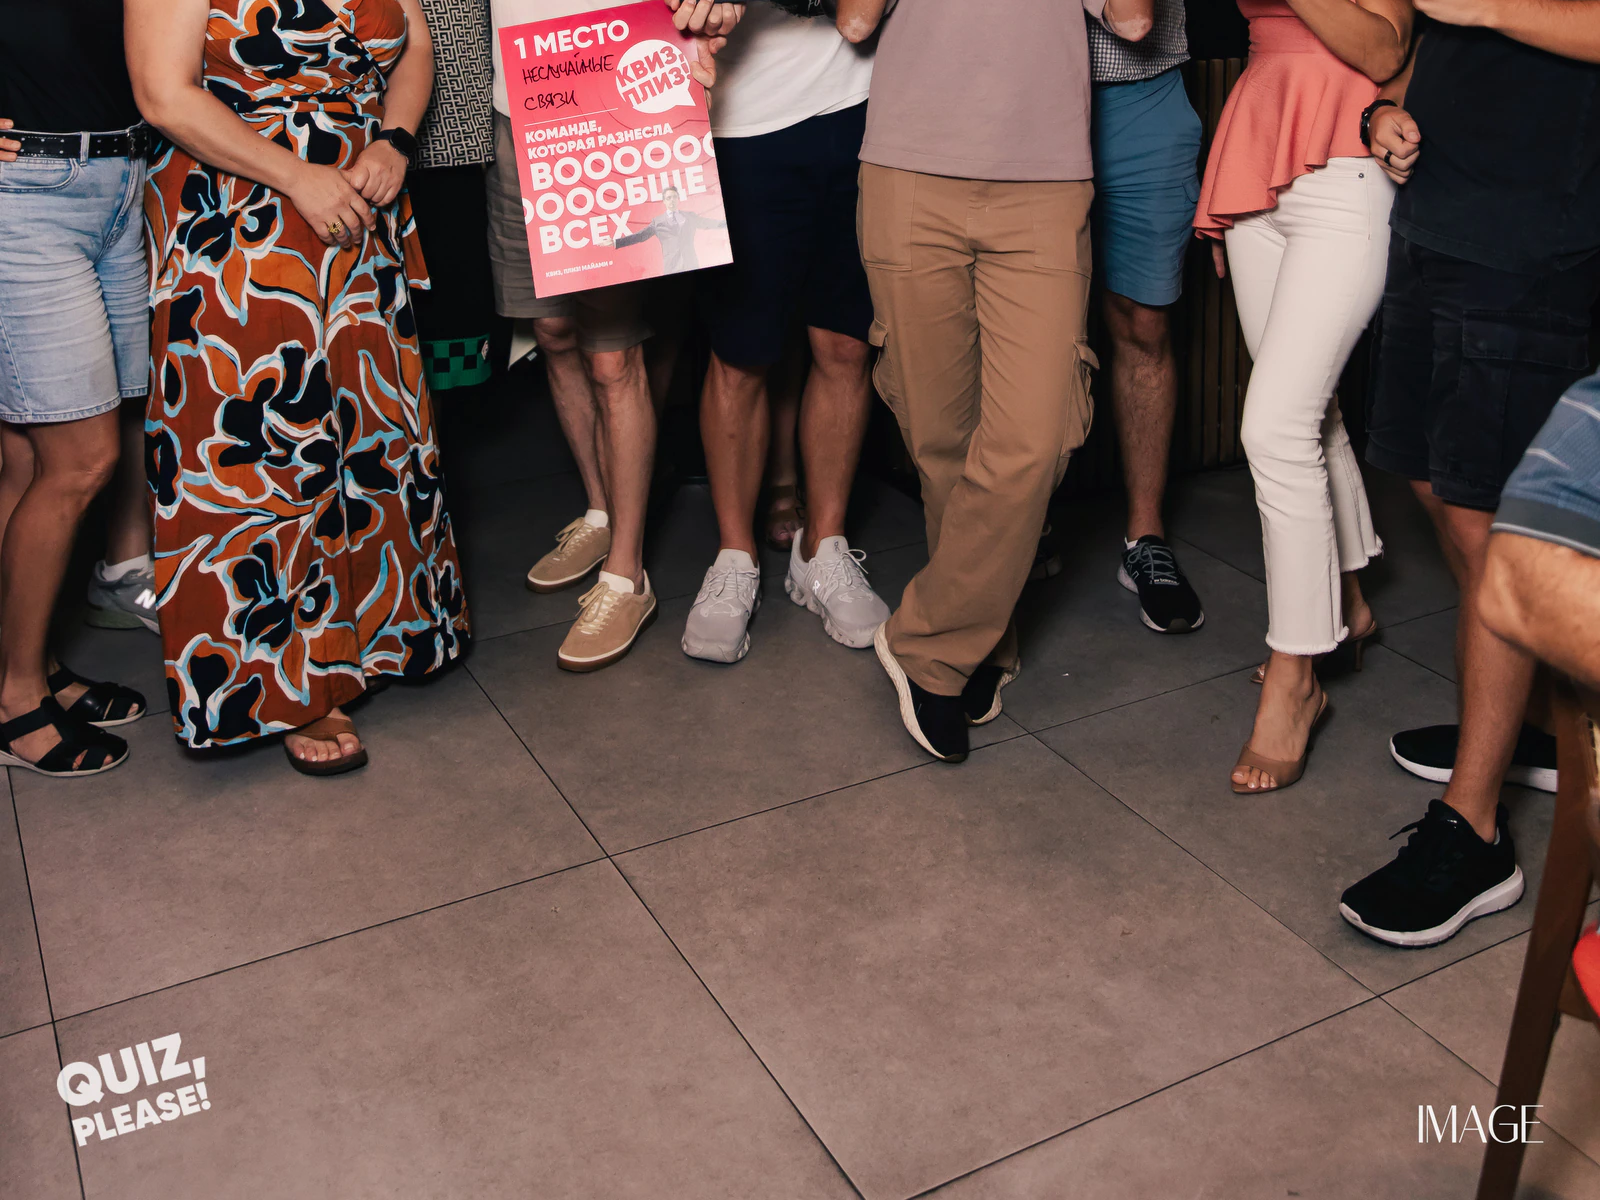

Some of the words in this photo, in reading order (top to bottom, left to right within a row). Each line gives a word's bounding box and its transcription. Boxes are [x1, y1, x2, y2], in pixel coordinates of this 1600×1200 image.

[514, 37, 527, 59] 1
[534, 19, 629, 57] МЕСТО
[522, 52, 614, 85] НЕСЛУЧАЙНЫЕ
[616, 46, 685, 87] КВИЗ,
[622, 63, 692, 106] ПЛИЗ!
[524, 90, 578, 110] СВЯЗИ
[525, 120, 602, 143] КОМАНДЕ,
[527, 137, 596, 160] КОТОРАЯ
[598, 122, 673, 146] РАЗНЕСЛА
[539, 210, 634, 254] ВСЕХ
